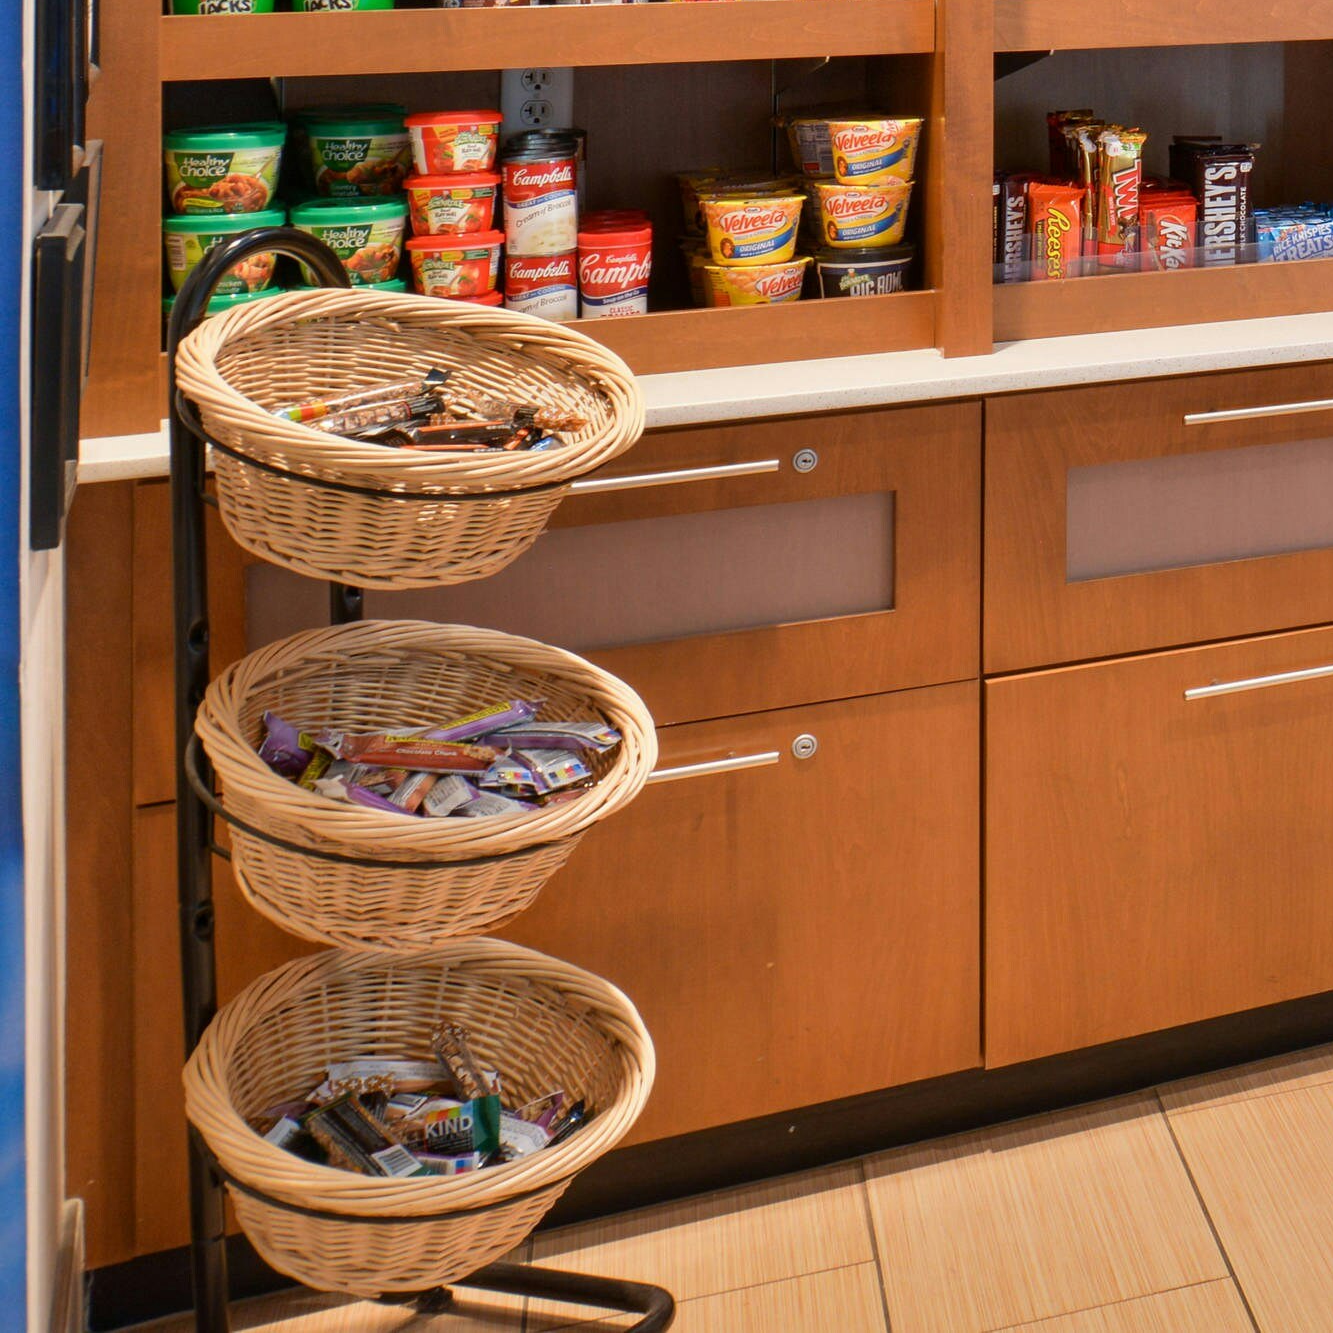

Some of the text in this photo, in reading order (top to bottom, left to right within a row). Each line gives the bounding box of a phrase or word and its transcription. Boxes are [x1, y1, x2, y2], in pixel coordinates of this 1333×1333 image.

[325, 141, 368, 154] Healthy
[836, 132, 893, 150] Velveeta
[184, 157, 230, 167] Healthy
[321, 149, 366, 161] Choice
[179, 164, 227, 178] Choice
[513, 167, 573, 187] Campbell's
[827, 197, 885, 214] Velveeta
[724, 215, 783, 233] Velveeta
[842, 224, 875, 236] ORIGINAL
[322, 228, 370, 240] Healthy
[739, 240, 774, 253] ORIGINAL
[509, 260, 570, 279] Campbell's
[425, 1117, 473, 1139] KIND
